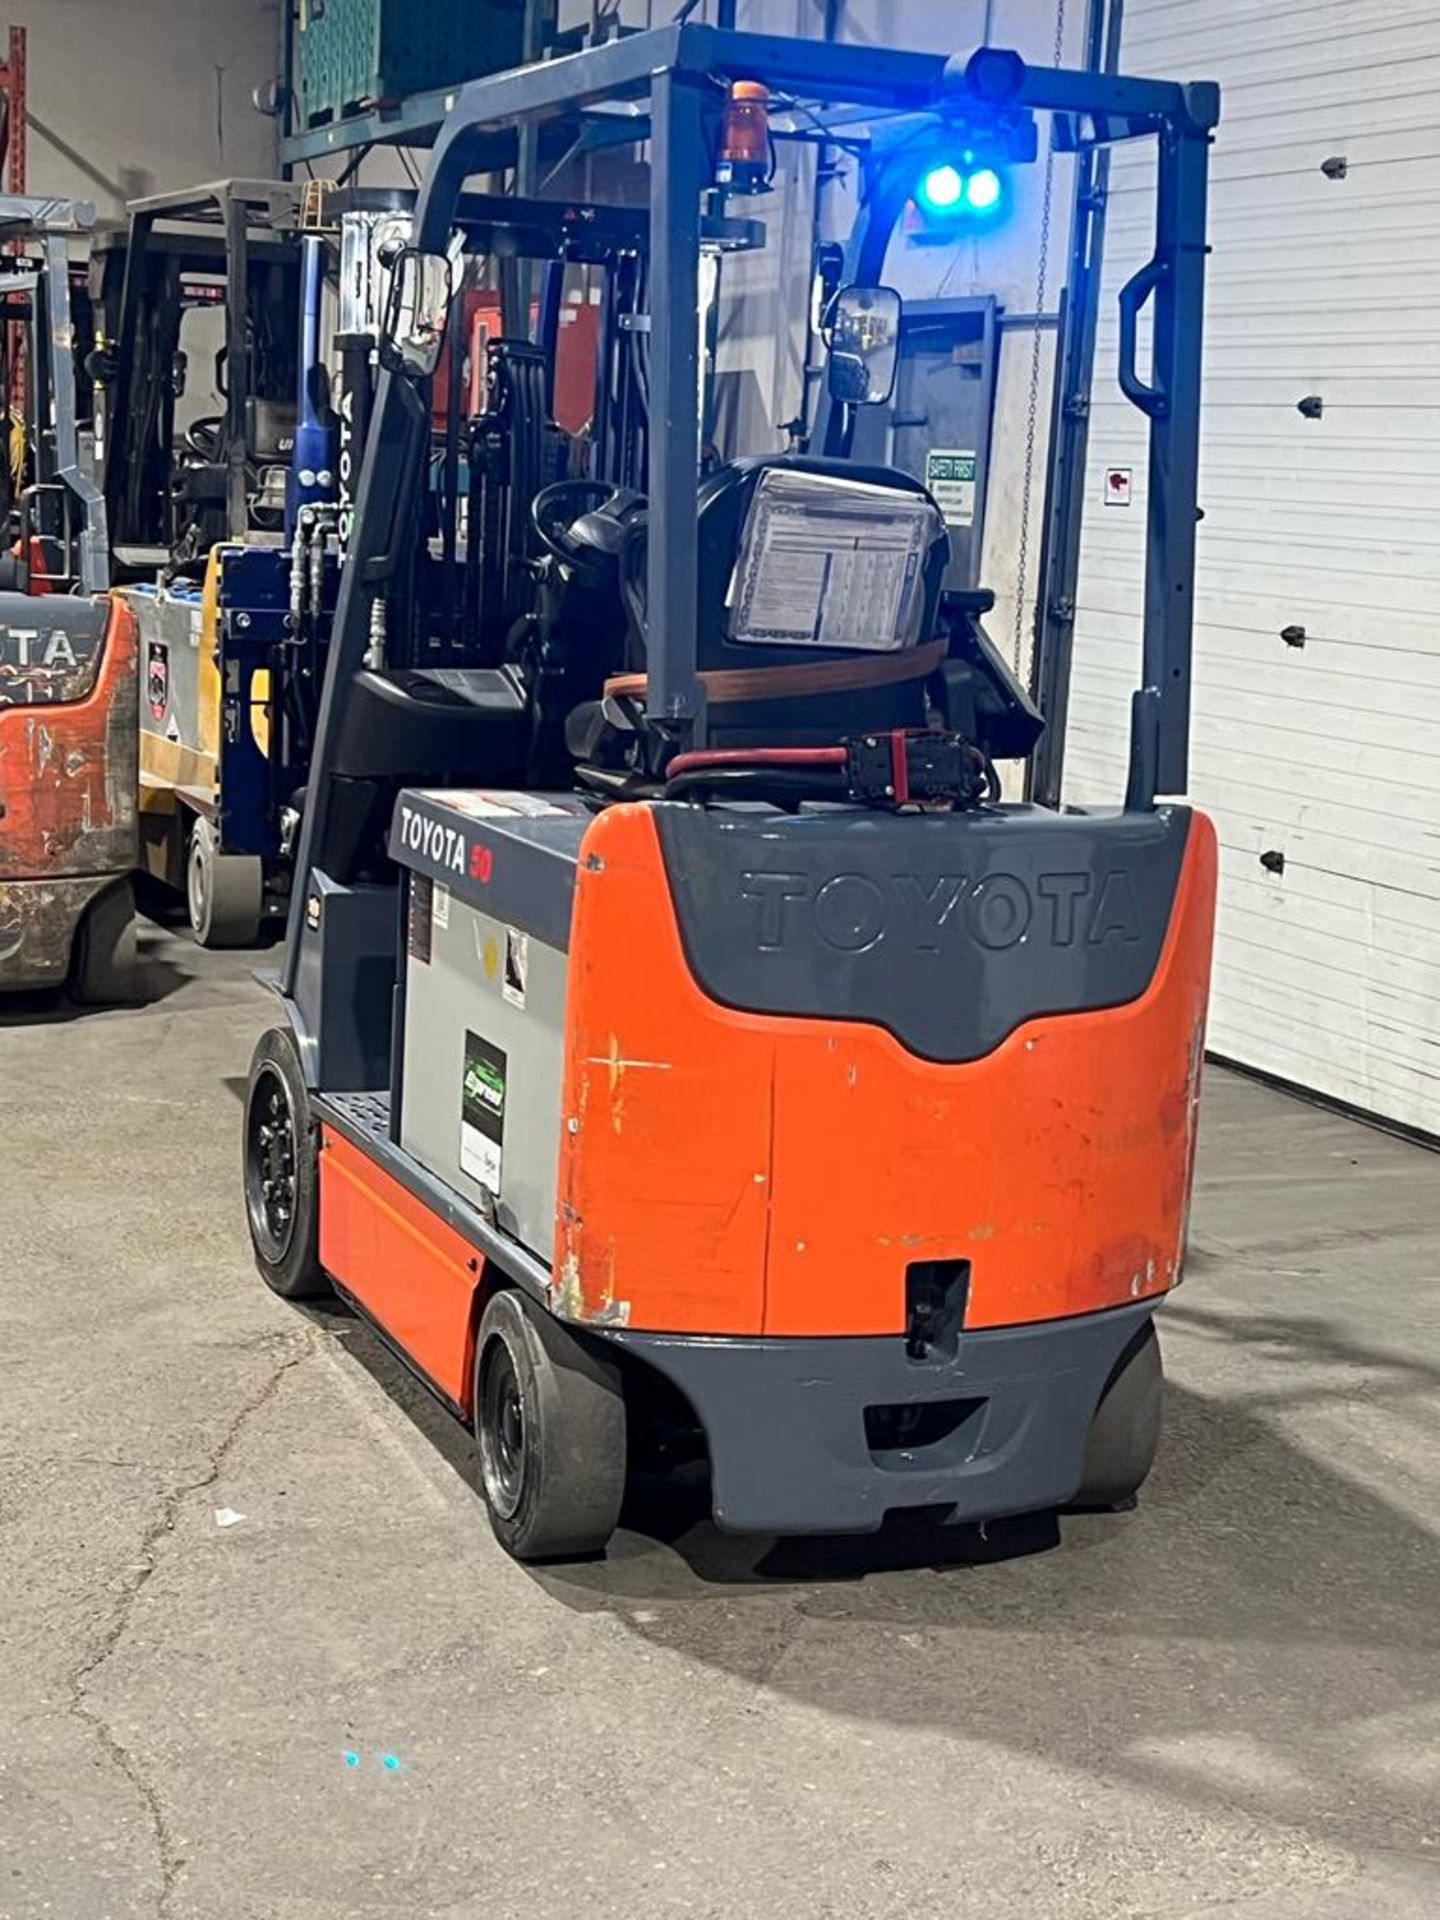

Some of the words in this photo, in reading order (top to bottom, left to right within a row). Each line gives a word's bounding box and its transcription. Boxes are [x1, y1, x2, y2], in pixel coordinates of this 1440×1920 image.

[337, 391, 354, 569] TOYOTA
[0, 627, 77, 667] TA
[402, 806, 465, 875] TOYOTA
[741, 870, 1140, 953] TOYOTA
